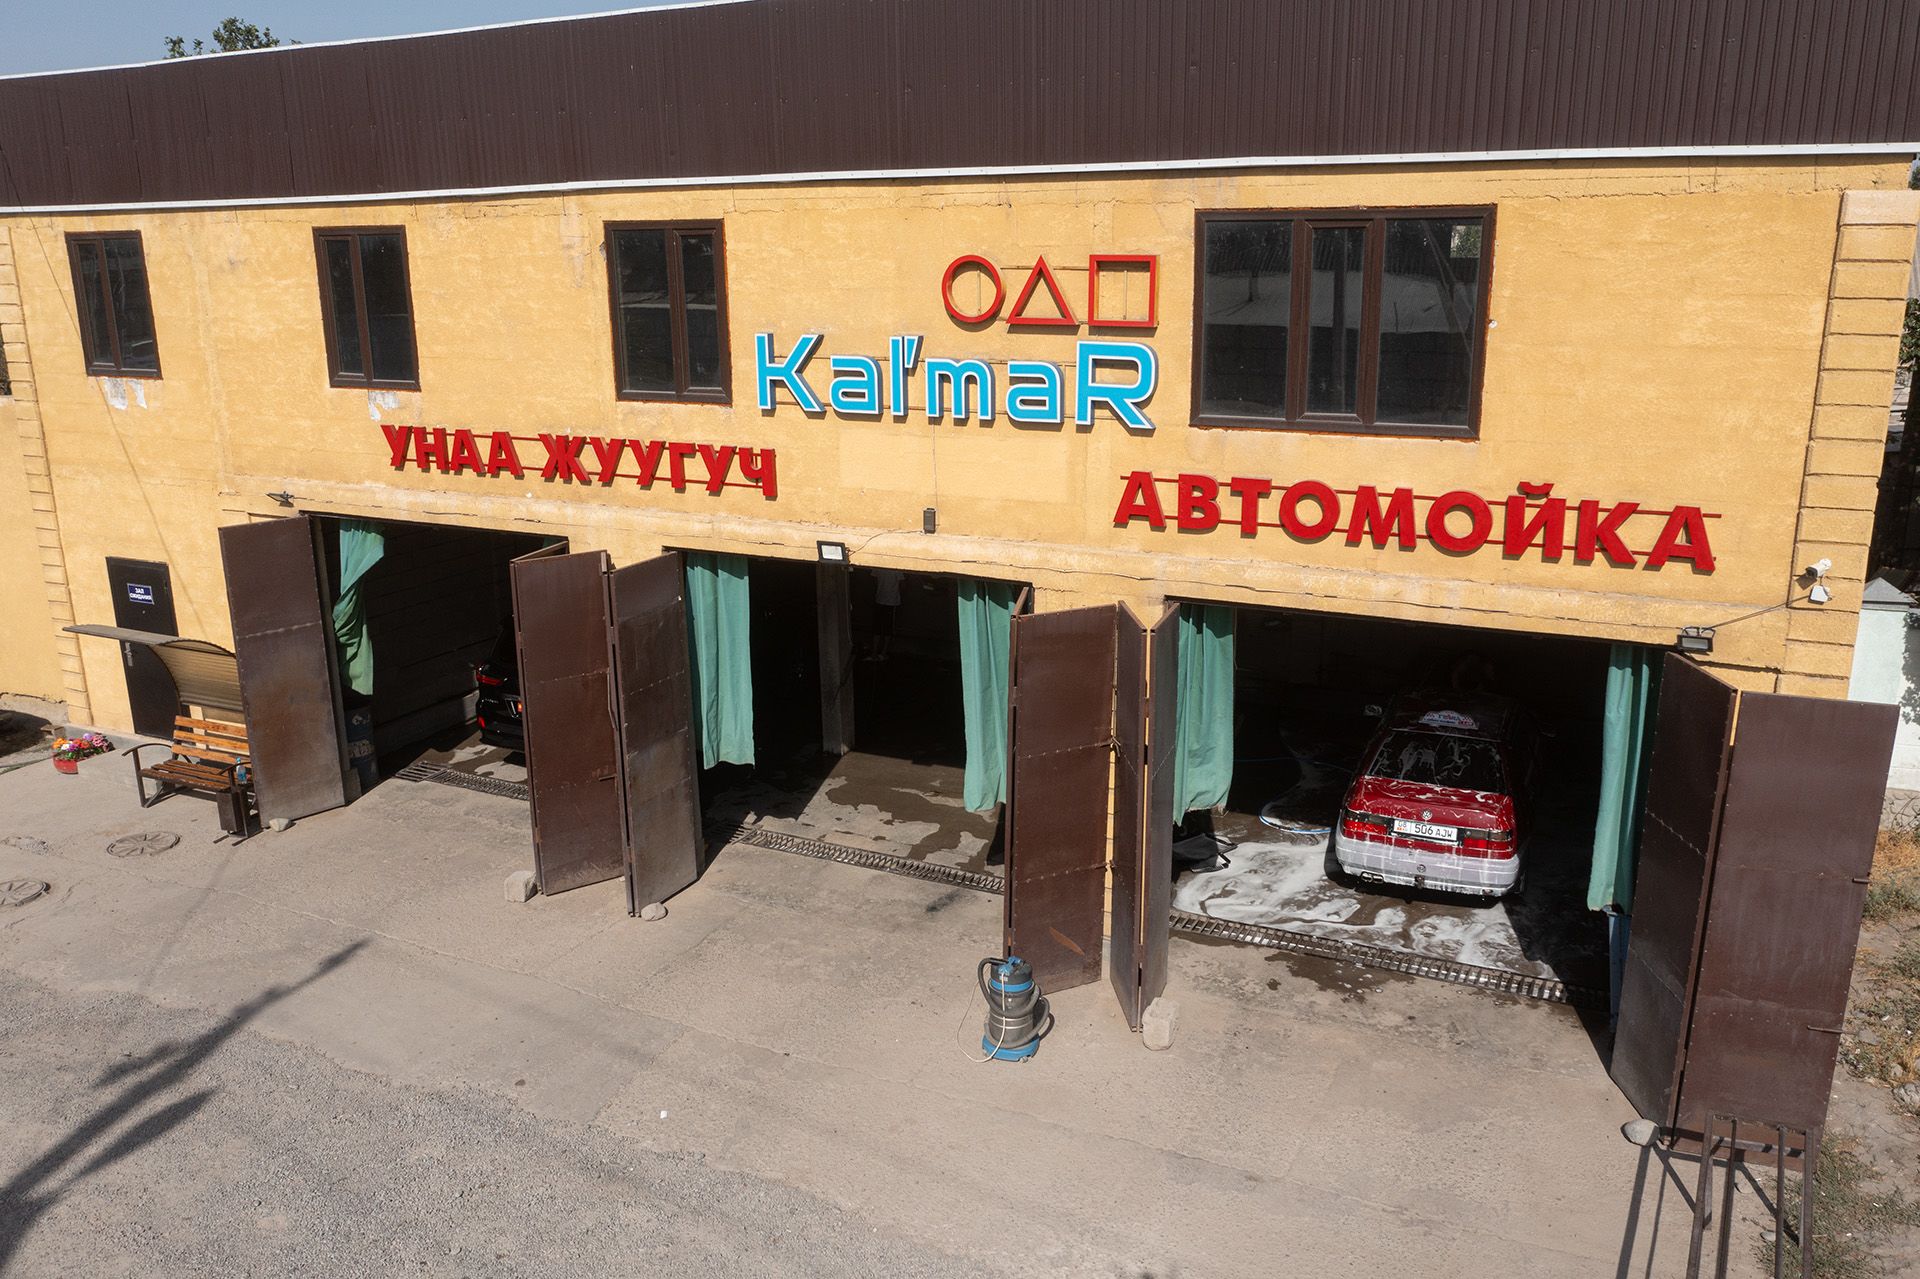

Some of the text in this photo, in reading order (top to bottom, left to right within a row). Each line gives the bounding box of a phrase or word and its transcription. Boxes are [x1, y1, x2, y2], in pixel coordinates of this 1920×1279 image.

[380, 424, 778, 498] УНАА ЖУУГУЧ
[1113, 471, 1716, 573] АВТОМОЙКА
[1415, 824, 1433, 835] 506
[1435, 828, 1453, 838] AJW
